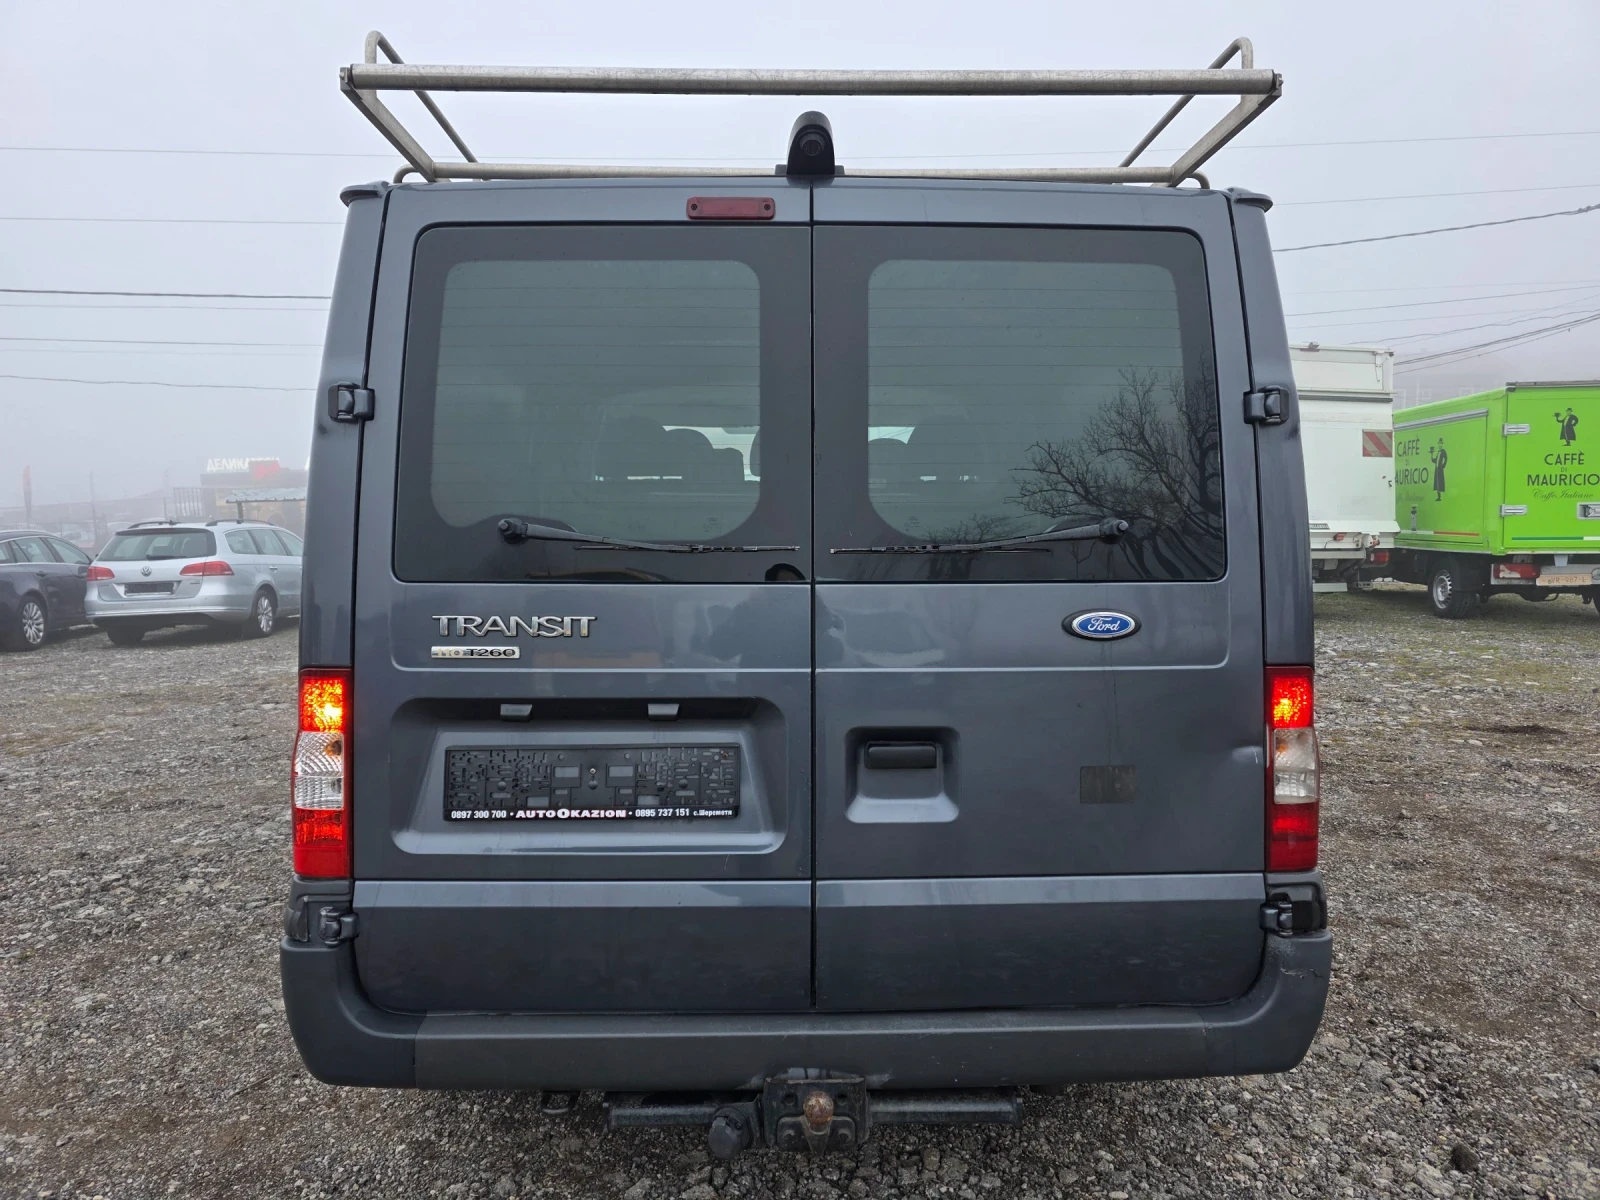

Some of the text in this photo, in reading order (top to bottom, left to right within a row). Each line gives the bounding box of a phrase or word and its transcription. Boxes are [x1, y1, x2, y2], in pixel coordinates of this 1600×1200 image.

[1397, 436, 1420, 457] CAFFÈ
[1544, 450, 1585, 466] CAFFÈ
[1395, 467, 1429, 485] AURICIO
[1527, 473, 1600, 487] MAURICIO
[432, 615, 597, 637] TRANSIT
[1087, 616, 1121, 631] Ford
[451, 810, 471, 819] 0897
[474, 810, 489, 819] 300
[492, 810, 506, 818] 700
[635, 809, 656, 817] 0895
[658, 809, 672, 817] 737
[675, 808, 690, 816] 151
